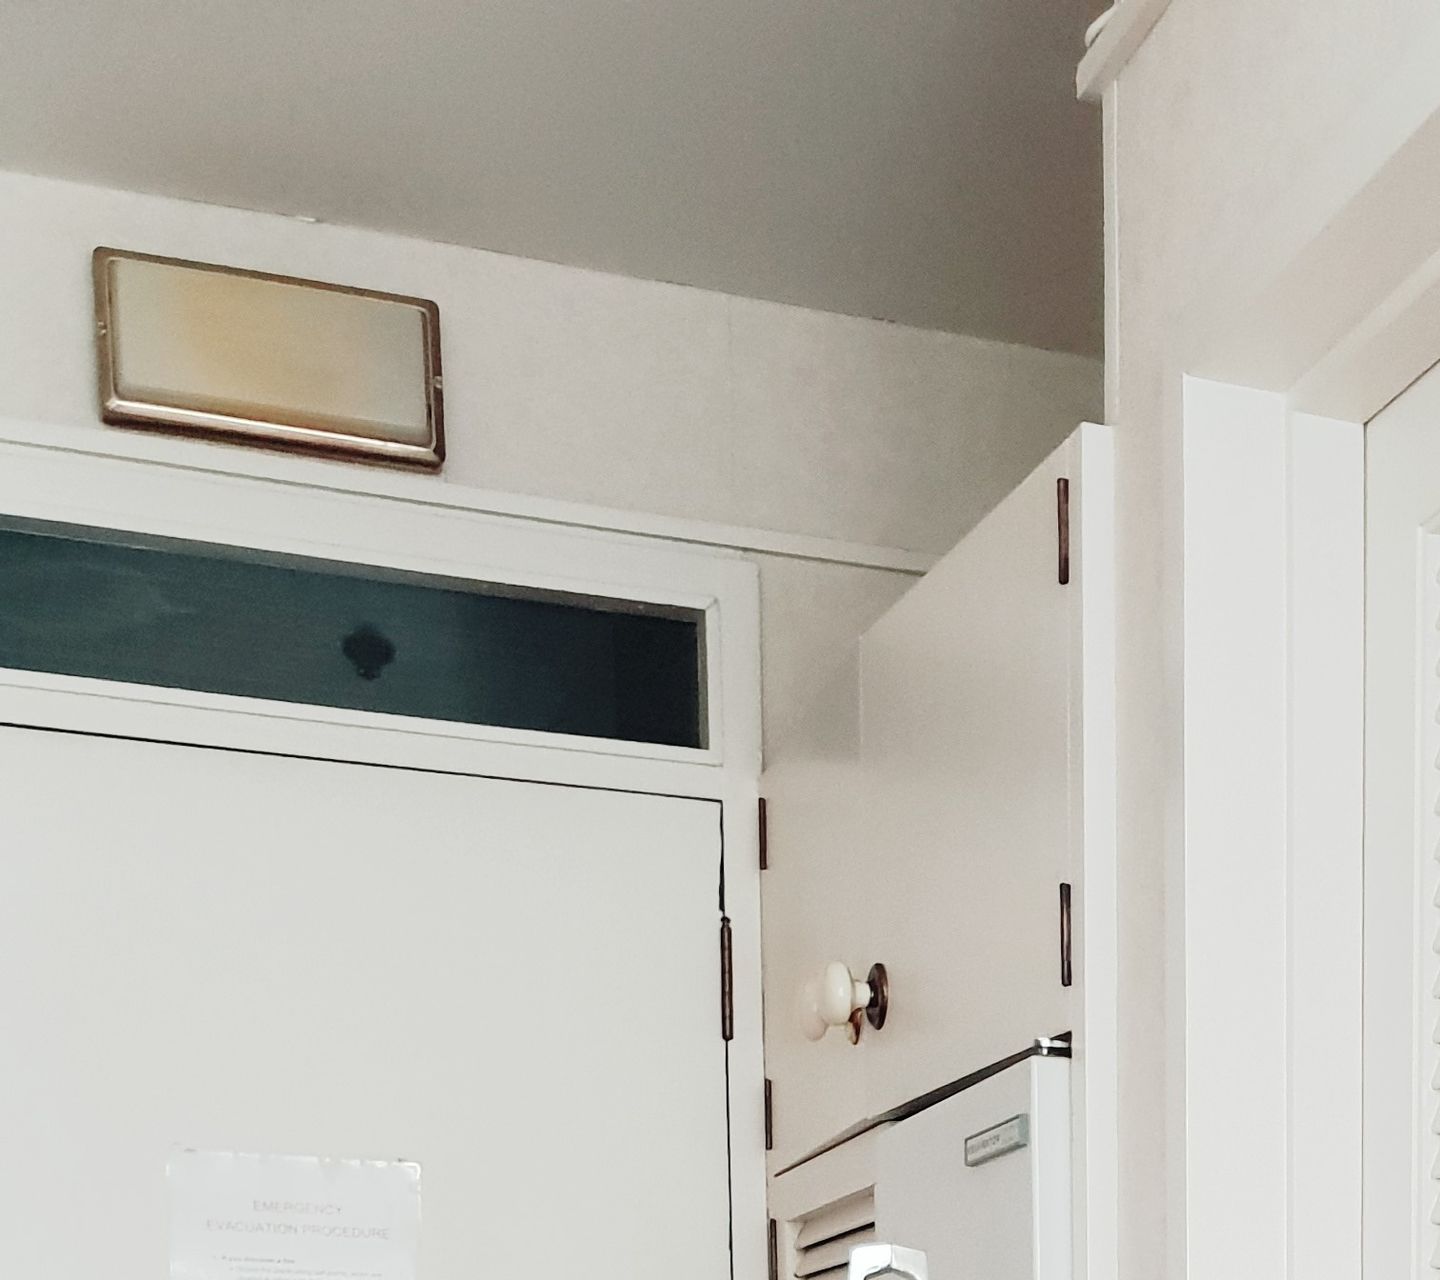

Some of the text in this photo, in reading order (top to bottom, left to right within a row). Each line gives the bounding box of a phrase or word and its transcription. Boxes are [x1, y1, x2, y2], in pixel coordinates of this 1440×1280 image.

[252, 1199, 342, 1216] EMERGENCY
[206, 1219, 390, 1241] EVACUATION PROCEDURE
